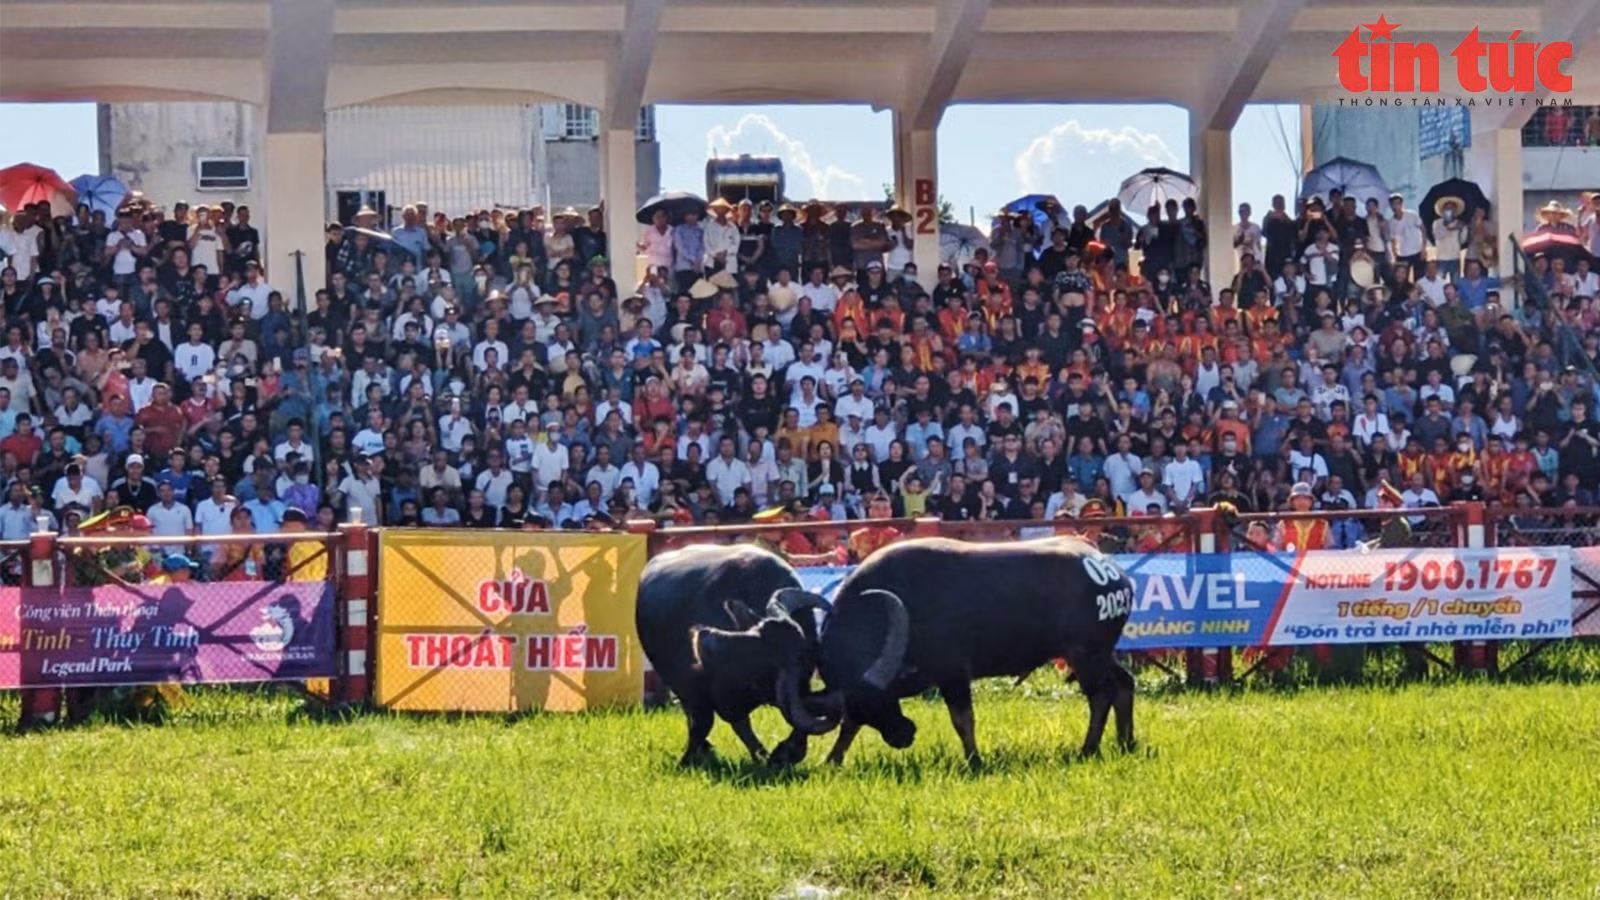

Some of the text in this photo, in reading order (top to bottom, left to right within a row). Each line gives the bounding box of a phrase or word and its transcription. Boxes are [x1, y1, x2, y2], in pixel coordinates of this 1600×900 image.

[1305, 558, 1557, 592] HOTLINE 1900.1767
[479, 569, 549, 613] CỬA
[1337, 601, 1350, 618] 1
[1351, 598, 1411, 620] tiếng
[23, 627, 72, 650] Tinh
[152, 625, 200, 649] Tinh
[1201, 620, 1250, 634] NINH
[406, 625, 616, 669] THOÁT HIỂM
[42, 657, 133, 676] Legend Park
